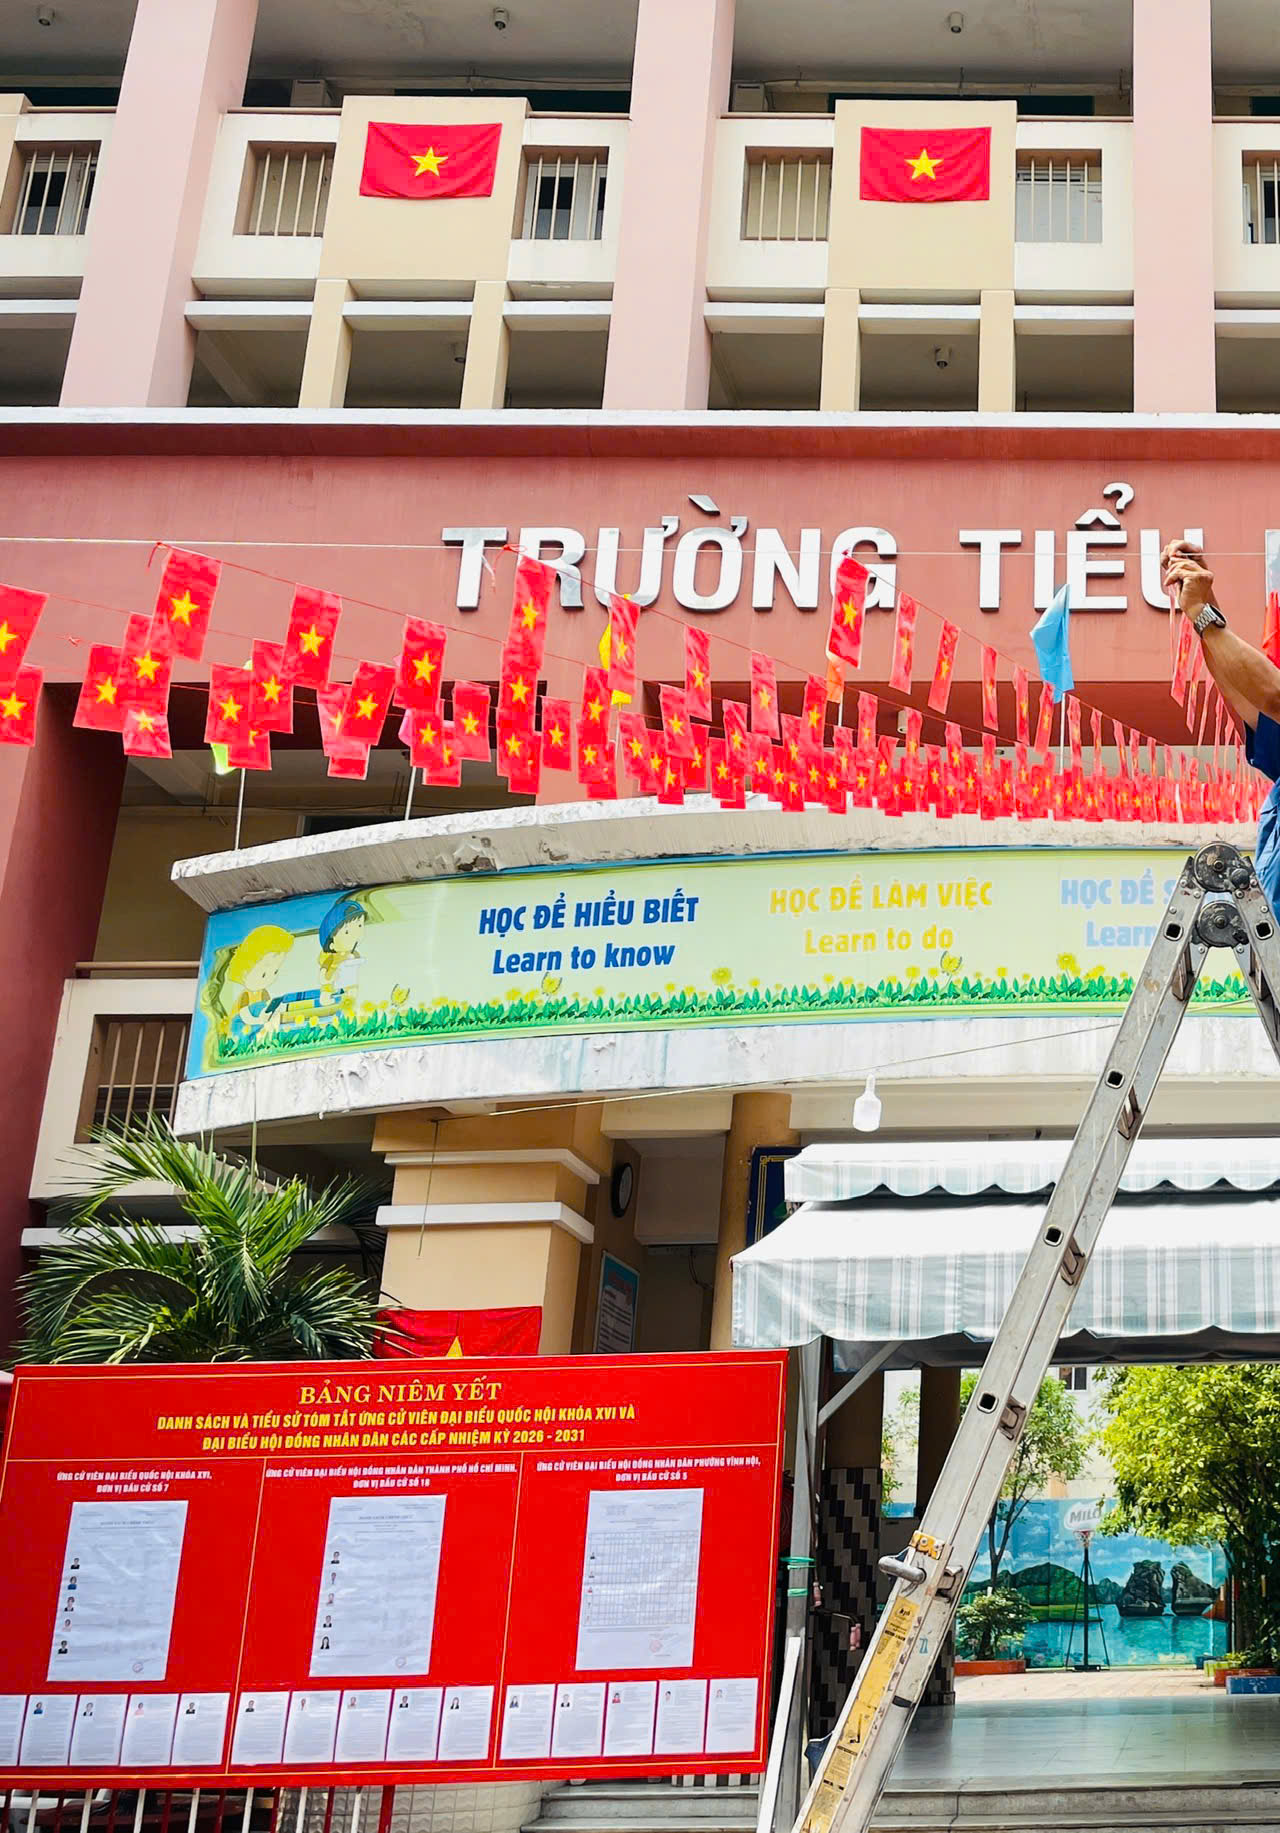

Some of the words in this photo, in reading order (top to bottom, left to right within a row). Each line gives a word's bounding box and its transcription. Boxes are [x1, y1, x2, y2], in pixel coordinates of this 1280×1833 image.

[442, 495, 898, 611] TRƯỜNG
[960, 482, 1203, 611] TIỂU
[769, 887, 821, 918] HỌC
[829, 874, 863, 911] ĐỂ
[871, 879, 928, 909] LÀM
[937, 877, 993, 910] VIỆC
[1061, 879, 1112, 909] HỌC
[1120, 868, 1154, 904] ĐỂ
[479, 906, 526, 937] HỌC
[533, 892, 566, 929] ĐỂ
[574, 890, 635, 927] HIỂU
[643, 888, 699, 924] BIẾT
[804, 928, 877, 954] Learn
[887, 926, 912, 951] to
[922, 923, 953, 950] do
[493, 950, 562, 974] Learn
[571, 946, 596, 969] to
[604, 943, 675, 968] know
[299, 1379, 371, 1404] BẢNG
[377, 1379, 446, 1403] NIÊM
[452, 1376, 502, 1401] YẾT
[157, 1416, 193, 1430] DANH
[195, 1413, 230, 1429] SÁCH
[233, 1412, 249, 1429] VÀ
[304, 1411, 330, 1427] TÓM
[359, 1409, 384, 1426] ỨNG
[387, 1407, 406, 1425] CỬ
[408, 1408, 437, 1424] VIÊN
[440, 1410, 462, 1426] ĐẠI
[497, 1405, 531, 1423] QUỐC
[534, 1406, 556, 1424] HỘI
[558, 1405, 592, 1421] KHÓA
[595, 1407, 616, 1420] XVI
[619, 1404, 635, 1420] VÀ
[202, 1436, 225, 1452] ĐẠI
[260, 1433, 282, 1452] HỘI
[323, 1432, 360, 1448] NHÂN
[362, 1431, 389, 1447] DÂN
[391, 1430, 417, 1446] CÁC
[420, 1428, 446, 1445] CẤP
[448, 1429, 491, 1447] NHIỆM
[512, 1430, 544, 1443] 2026
[555, 1429, 585, 1442] 2031
[164, 1484, 169, 1492] 7
